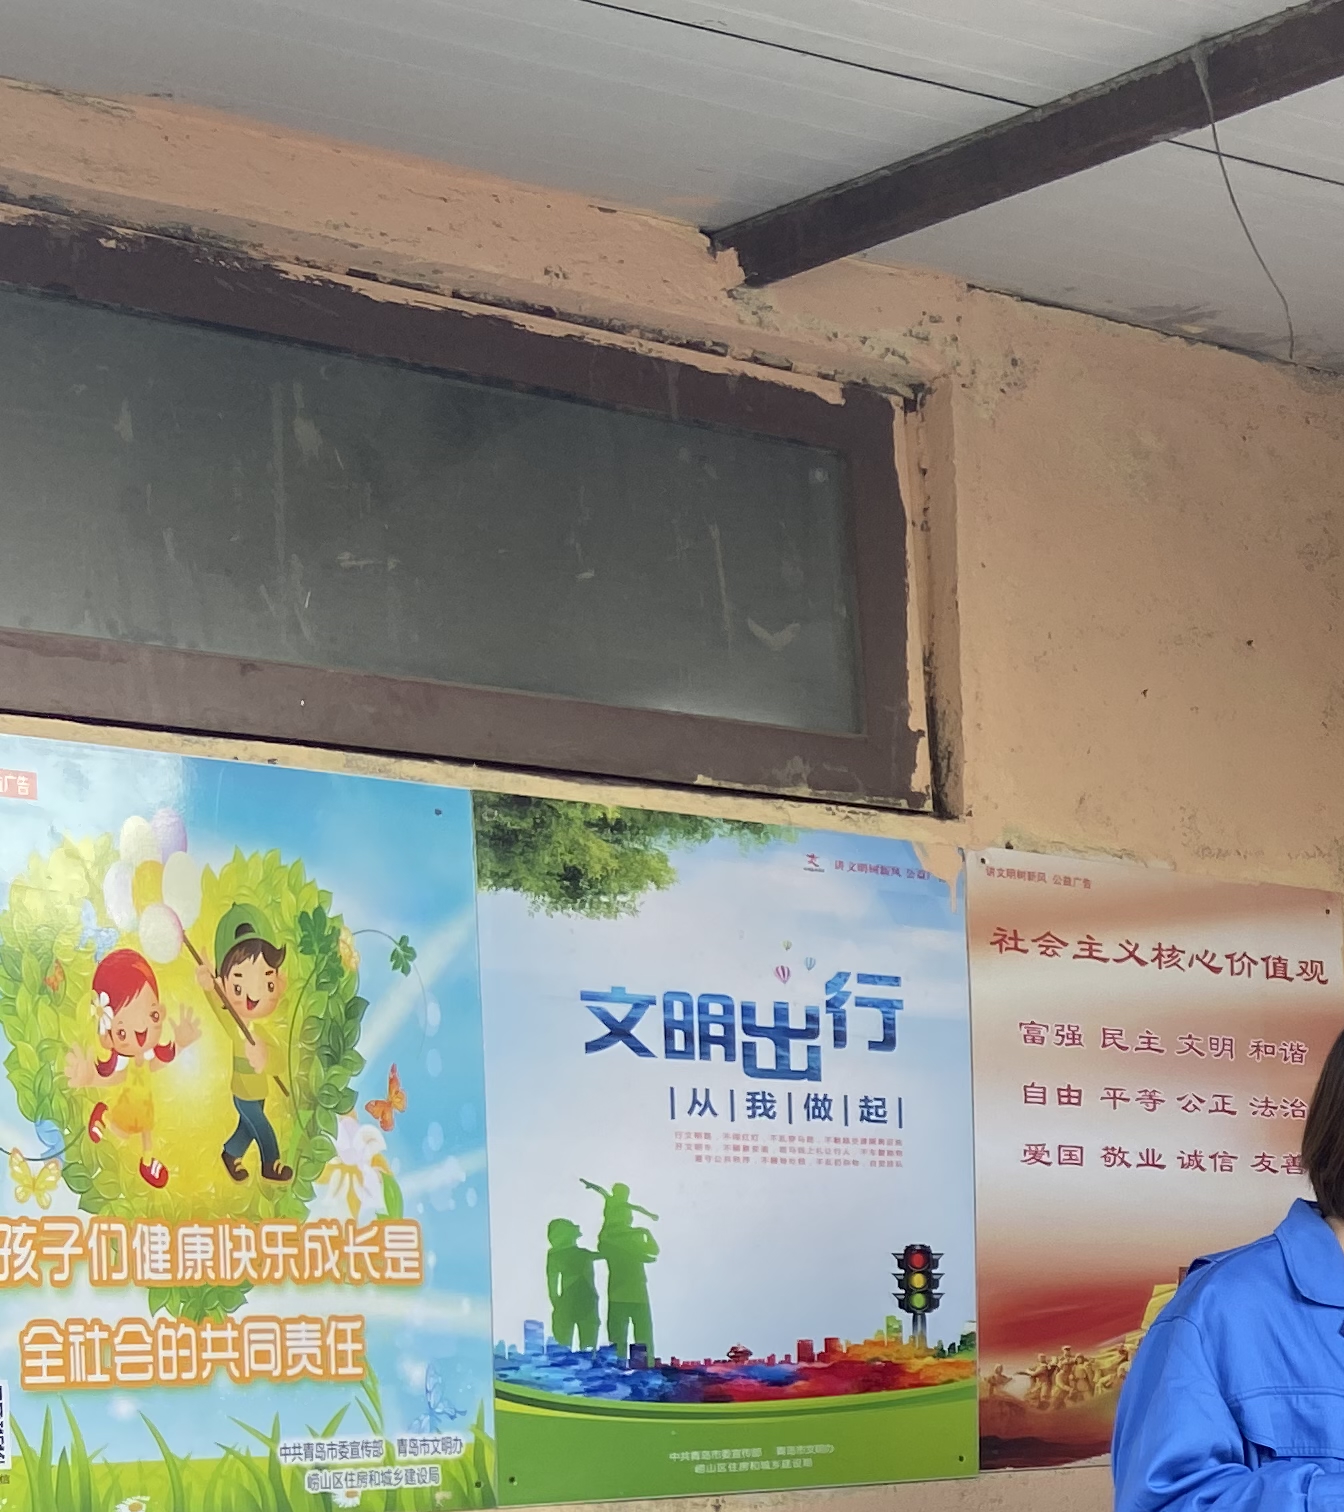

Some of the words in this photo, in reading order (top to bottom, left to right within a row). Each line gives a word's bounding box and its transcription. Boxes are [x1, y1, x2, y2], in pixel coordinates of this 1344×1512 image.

[0, 774, 30, 796] 广告
[1052, 874, 1091, 889] 公益广告
[990, 927, 1329, 985] 社会主义核心价值观
[579, 971, 904, 1082] 文明出行
[1018, 1020, 1084, 1047] 富强
[1100, 1027, 1165, 1055] 民主
[1175, 1033, 1235, 1060] 文明
[1248, 1040, 1308, 1065] 和谐
[1022, 1081, 1083, 1108] 自由
[1100, 1087, 1166, 1112] 平等
[1176, 1092, 1238, 1116] 公正
[1249, 1096, 1307, 1119] 法治
[1020, 1143, 1084, 1167] 爱国
[1101, 1145, 1166, 1170] 敬业
[1177, 1149, 1238, 1173] 诚信
[1250, 1151, 1306, 1175] 友善
[0, 1222, 421, 1282] 孩子们健康快乐成长是
[23, 1322, 364, 1384] 全社会的共同责任
[280, 1439, 384, 1463] 中共青岛市委宣传部
[396, 1436, 463, 1457] 青岛市文明办
